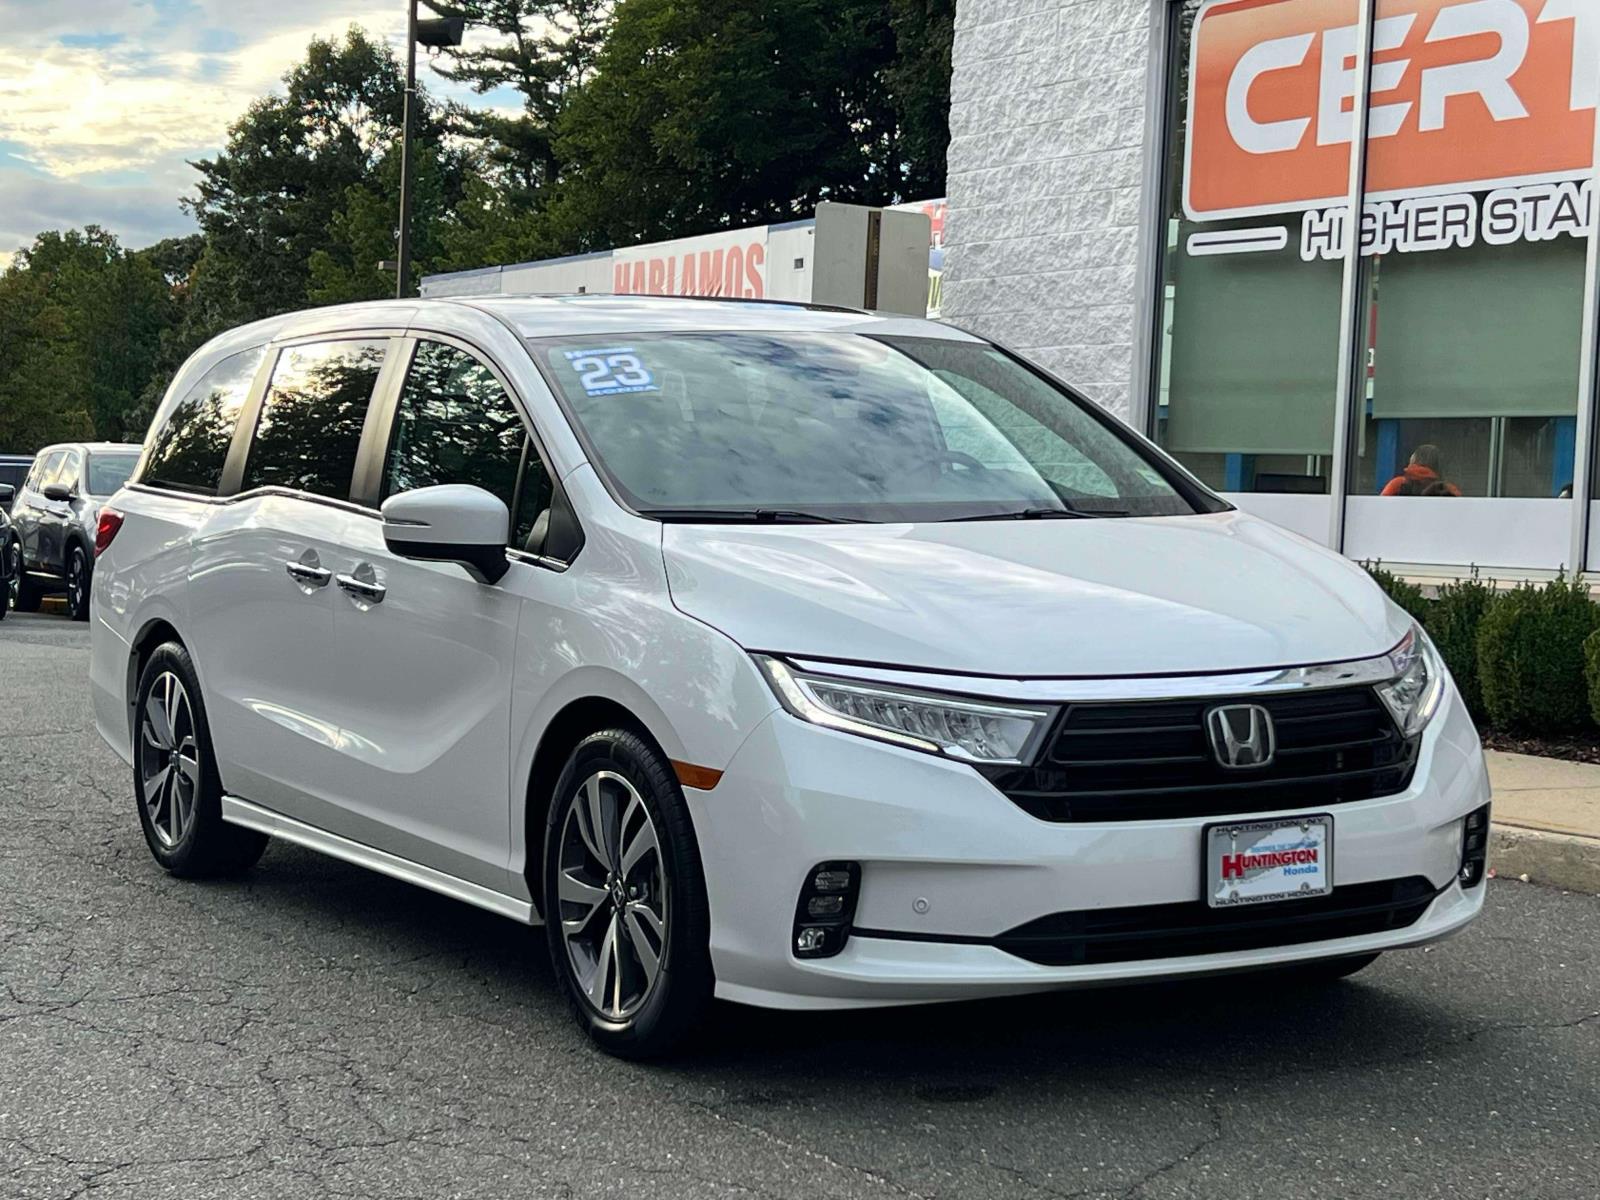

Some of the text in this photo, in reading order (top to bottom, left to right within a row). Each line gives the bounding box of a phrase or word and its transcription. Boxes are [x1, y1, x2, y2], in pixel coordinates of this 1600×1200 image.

[1486, 186, 1593, 239] STA
[572, 354, 651, 390] 23
[1221, 848, 1318, 880] HUNTINGTON
[1283, 865, 1318, 876] Honda
[1215, 889, 1325, 906] HUNTINGTON HONDA
